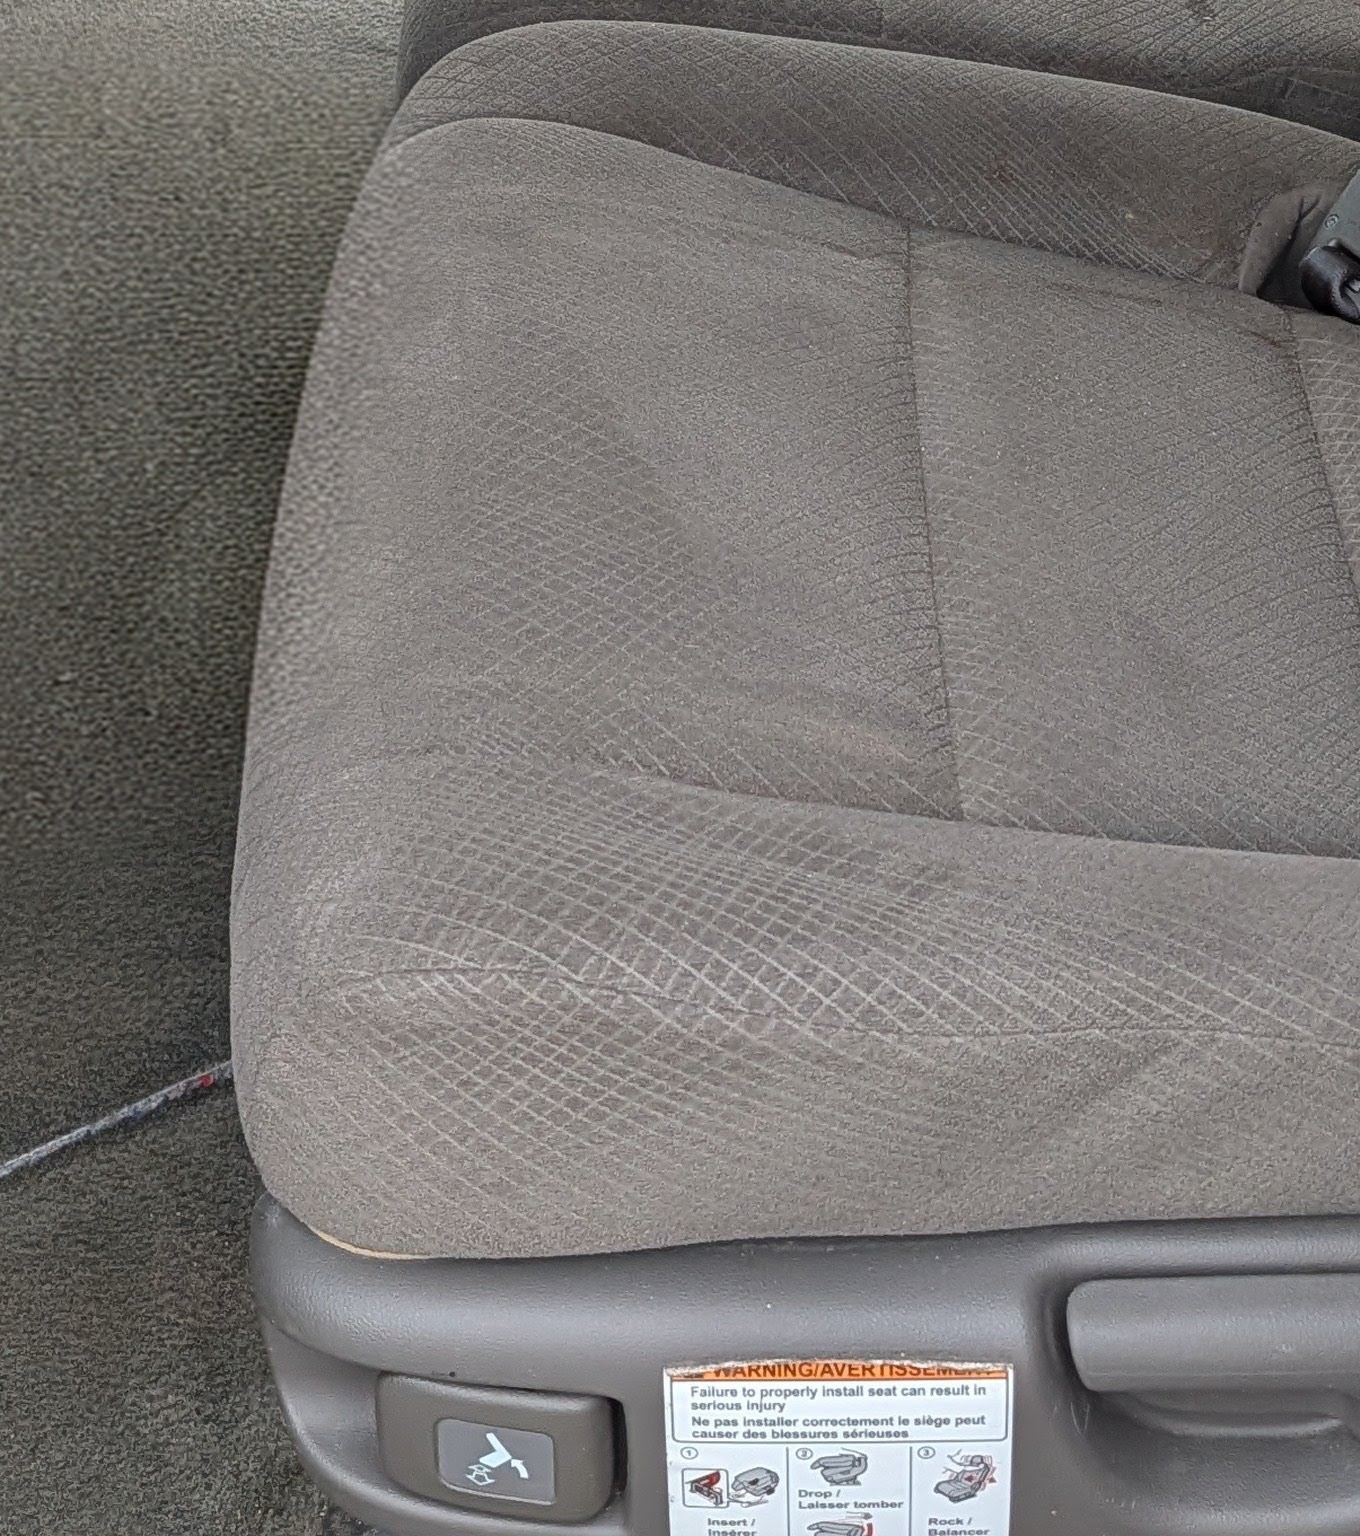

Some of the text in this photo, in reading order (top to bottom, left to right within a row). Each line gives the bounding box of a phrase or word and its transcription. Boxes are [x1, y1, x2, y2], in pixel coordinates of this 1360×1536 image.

[713, 1362, 992, 1378] WARNING/AVERTISSE
[691, 1384, 986, 1400] Failure to properly install seat can result in
[691, 1400, 786, 1412] serious injury
[692, 1415, 986, 1428] Ne pas installer correctement le siège peut
[692, 1429, 909, 1439] causer des blessures sérieuses
[798, 1489, 832, 1499] Drop
[798, 1500, 904, 1509] Laisser tomber
[707, 1518, 747, 1526] Insert
[928, 1517, 964, 1526] Rock
